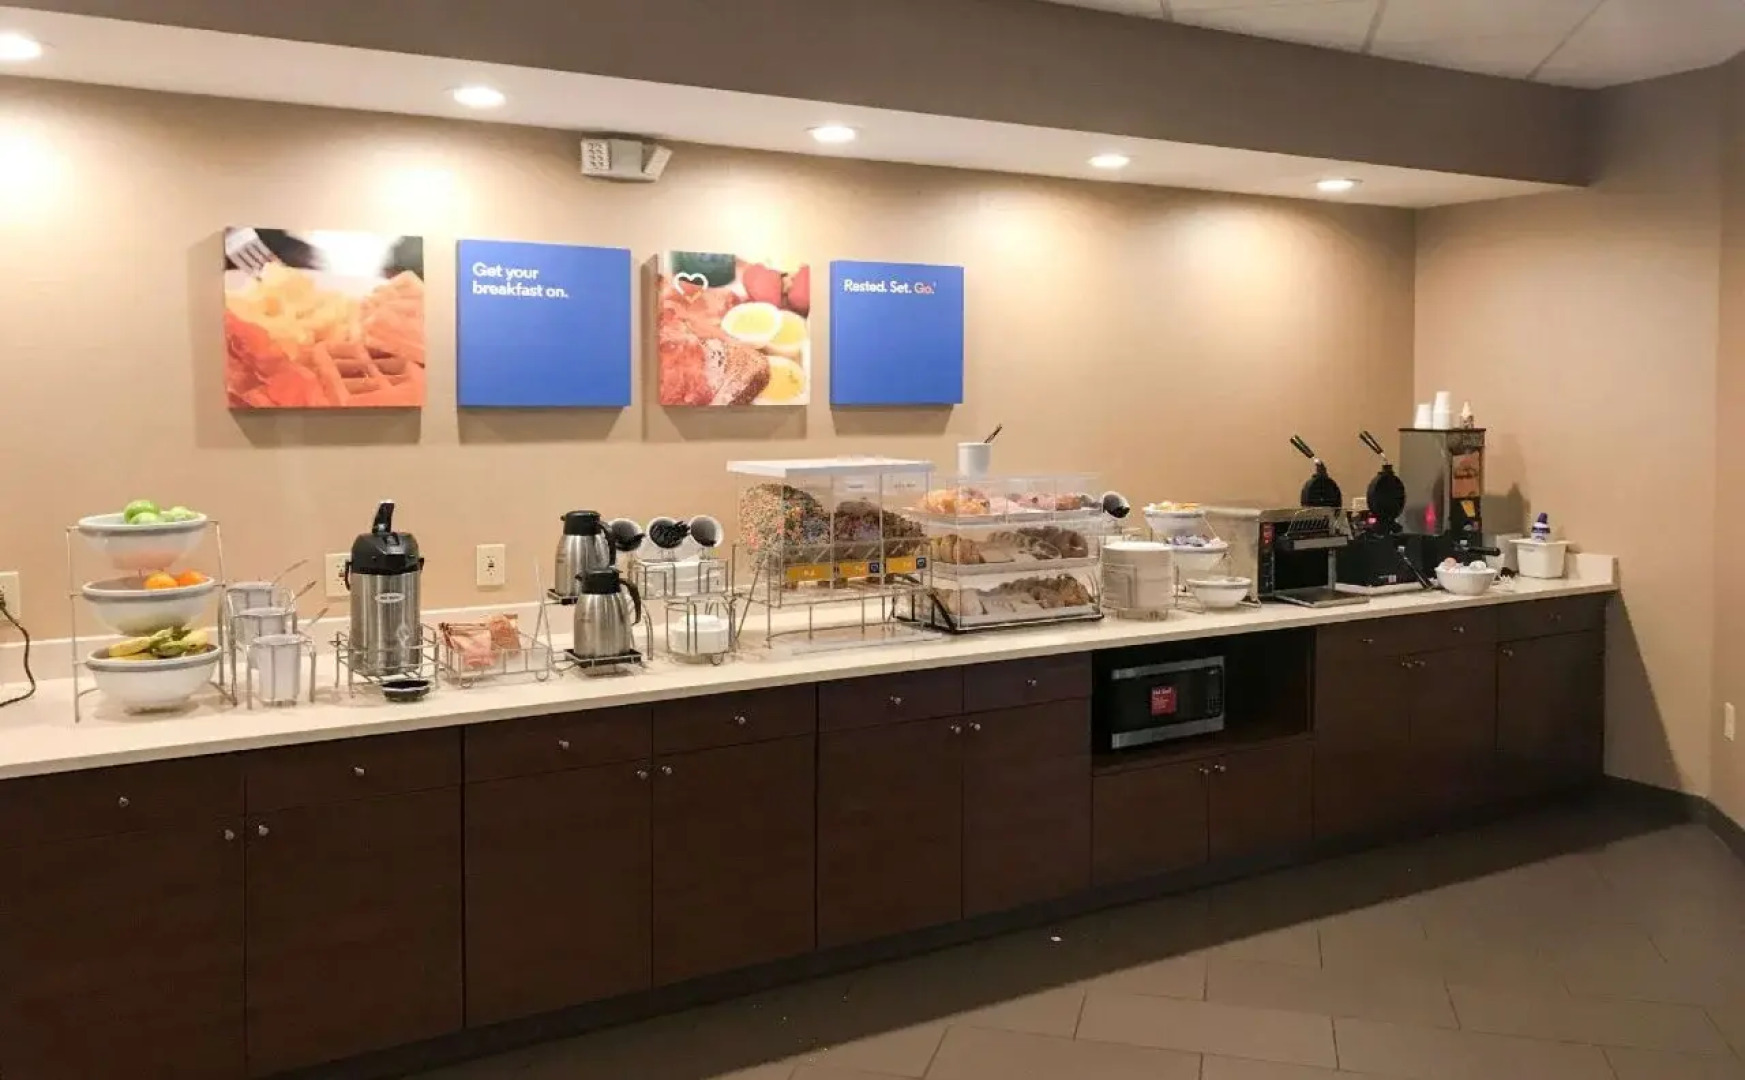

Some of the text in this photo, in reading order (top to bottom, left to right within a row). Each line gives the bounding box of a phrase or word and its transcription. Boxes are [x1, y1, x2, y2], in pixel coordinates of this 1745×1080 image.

[472, 262, 539, 281] Get your
[472, 280, 569, 298] breakfast on.
[844, 279, 887, 293] Rested.
[890, 281, 912, 294] Set.
